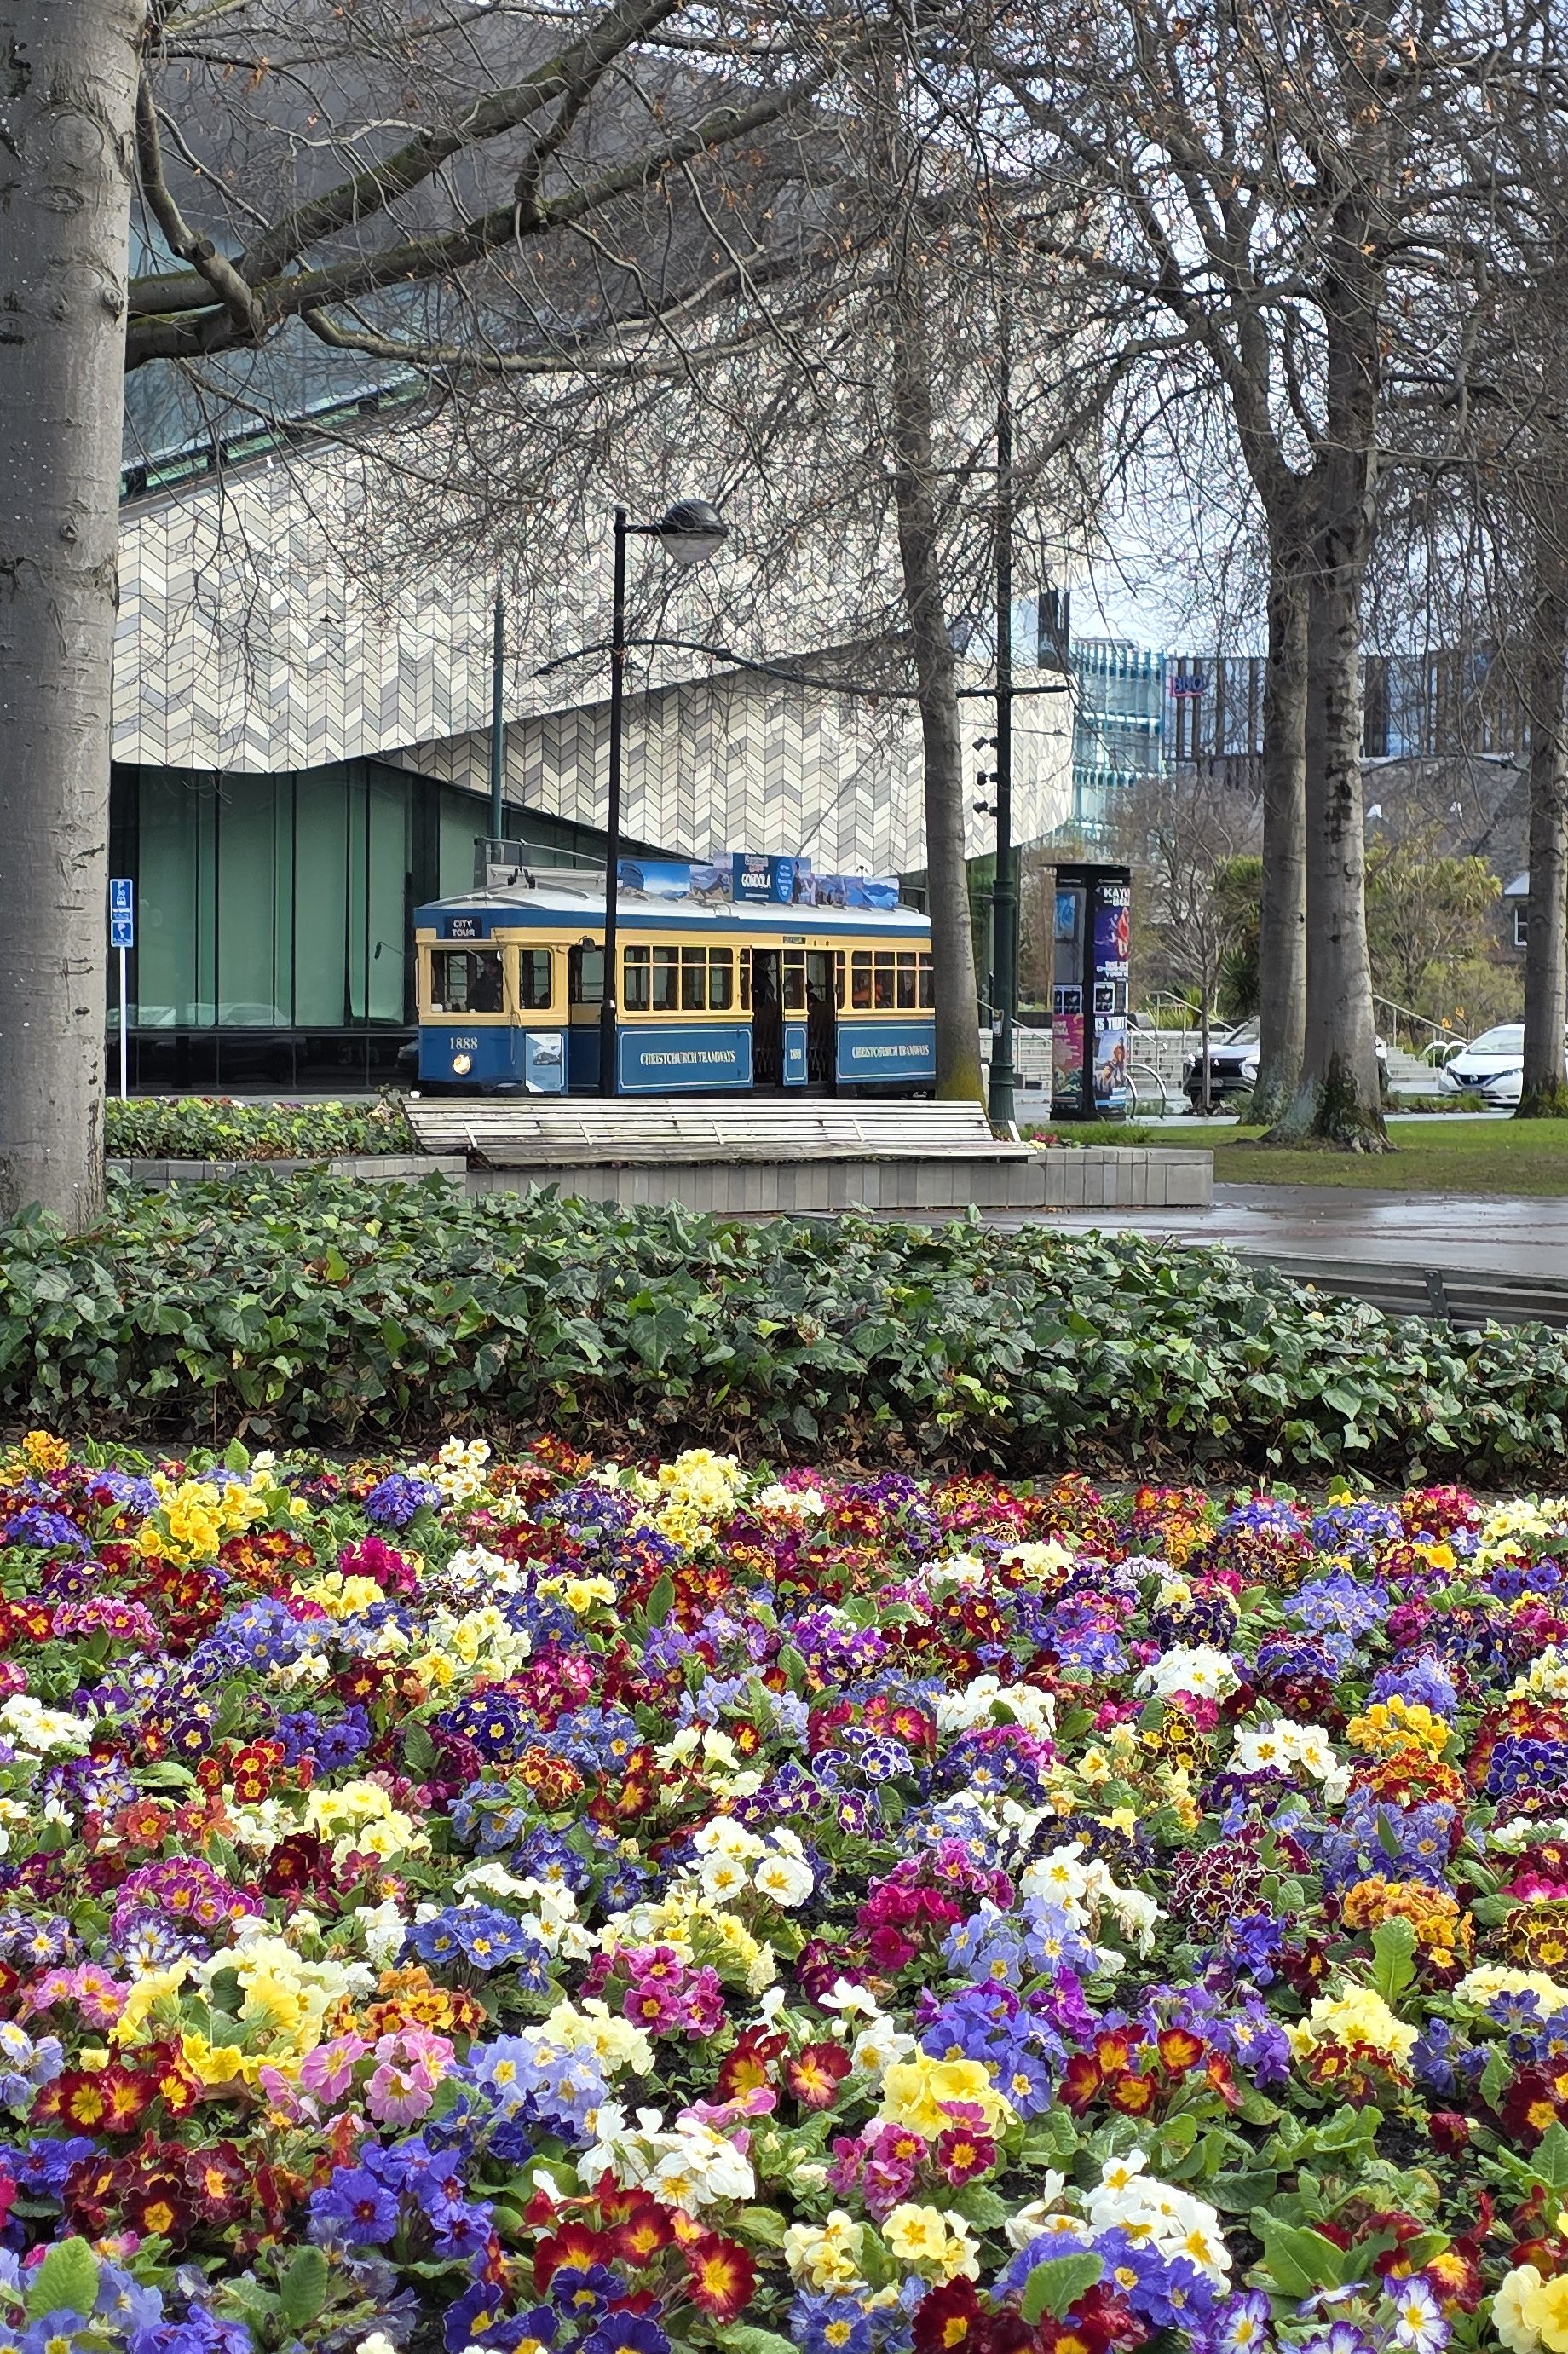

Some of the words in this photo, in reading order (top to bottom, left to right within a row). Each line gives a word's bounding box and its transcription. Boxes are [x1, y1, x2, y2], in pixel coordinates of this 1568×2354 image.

[741, 873, 771, 889] GONDOLA
[453, 919, 472, 928] CITY
[452, 928, 476, 937] TOUR
[450, 1036, 478, 1050] 1888
[640, 1051, 697, 1066] CHRISTCHURCH
[697, 1049, 735, 1064] TRAMWAYS
[852, 1046, 898, 1059] CHRISTCHURCH
[899, 1045, 930, 1057] TRAMWAYS
